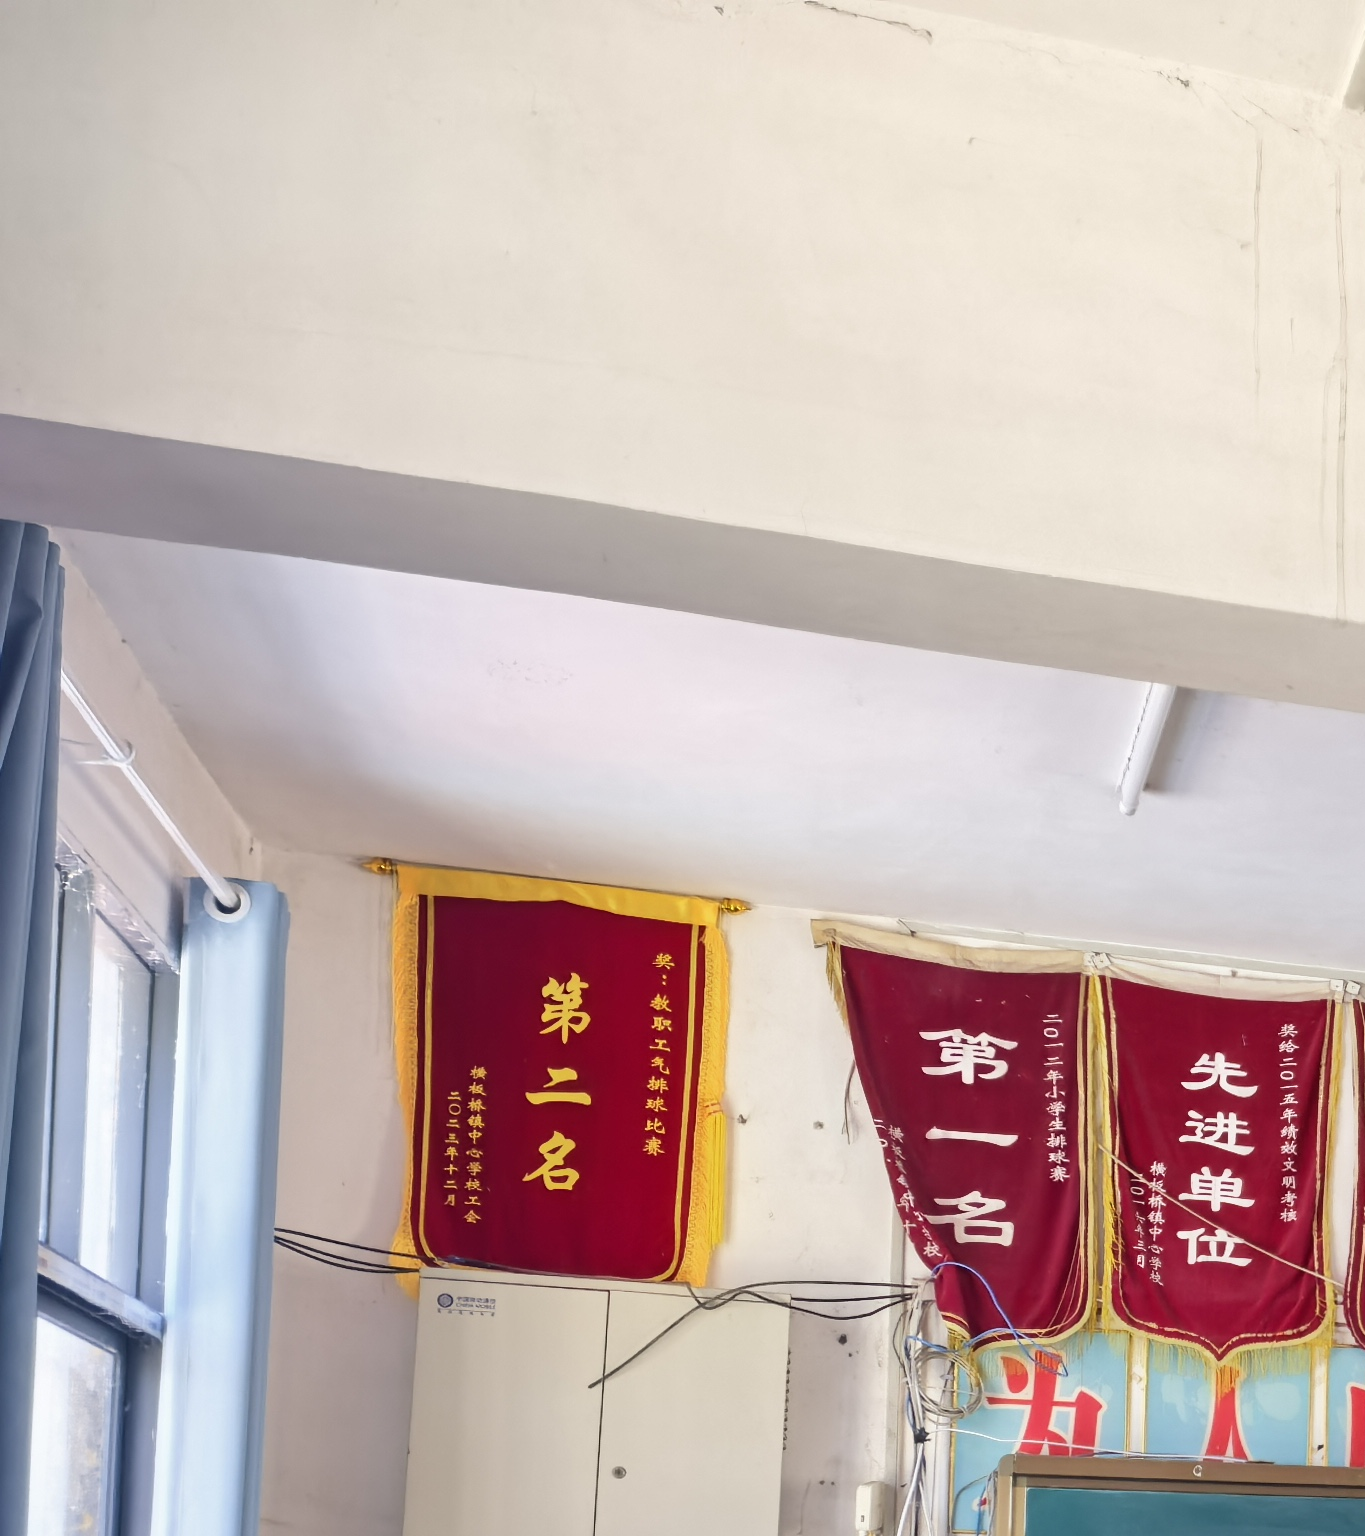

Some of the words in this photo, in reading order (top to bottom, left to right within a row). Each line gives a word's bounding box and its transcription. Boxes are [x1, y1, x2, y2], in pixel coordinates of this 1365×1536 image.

[463, 1064, 488, 1224] 横板桥镇中心学校工会
[521, 972, 592, 1191] 第二名
[918, 1028, 1019, 1247] 第一名
[1176, 1051, 1258, 1268] 先进单位
